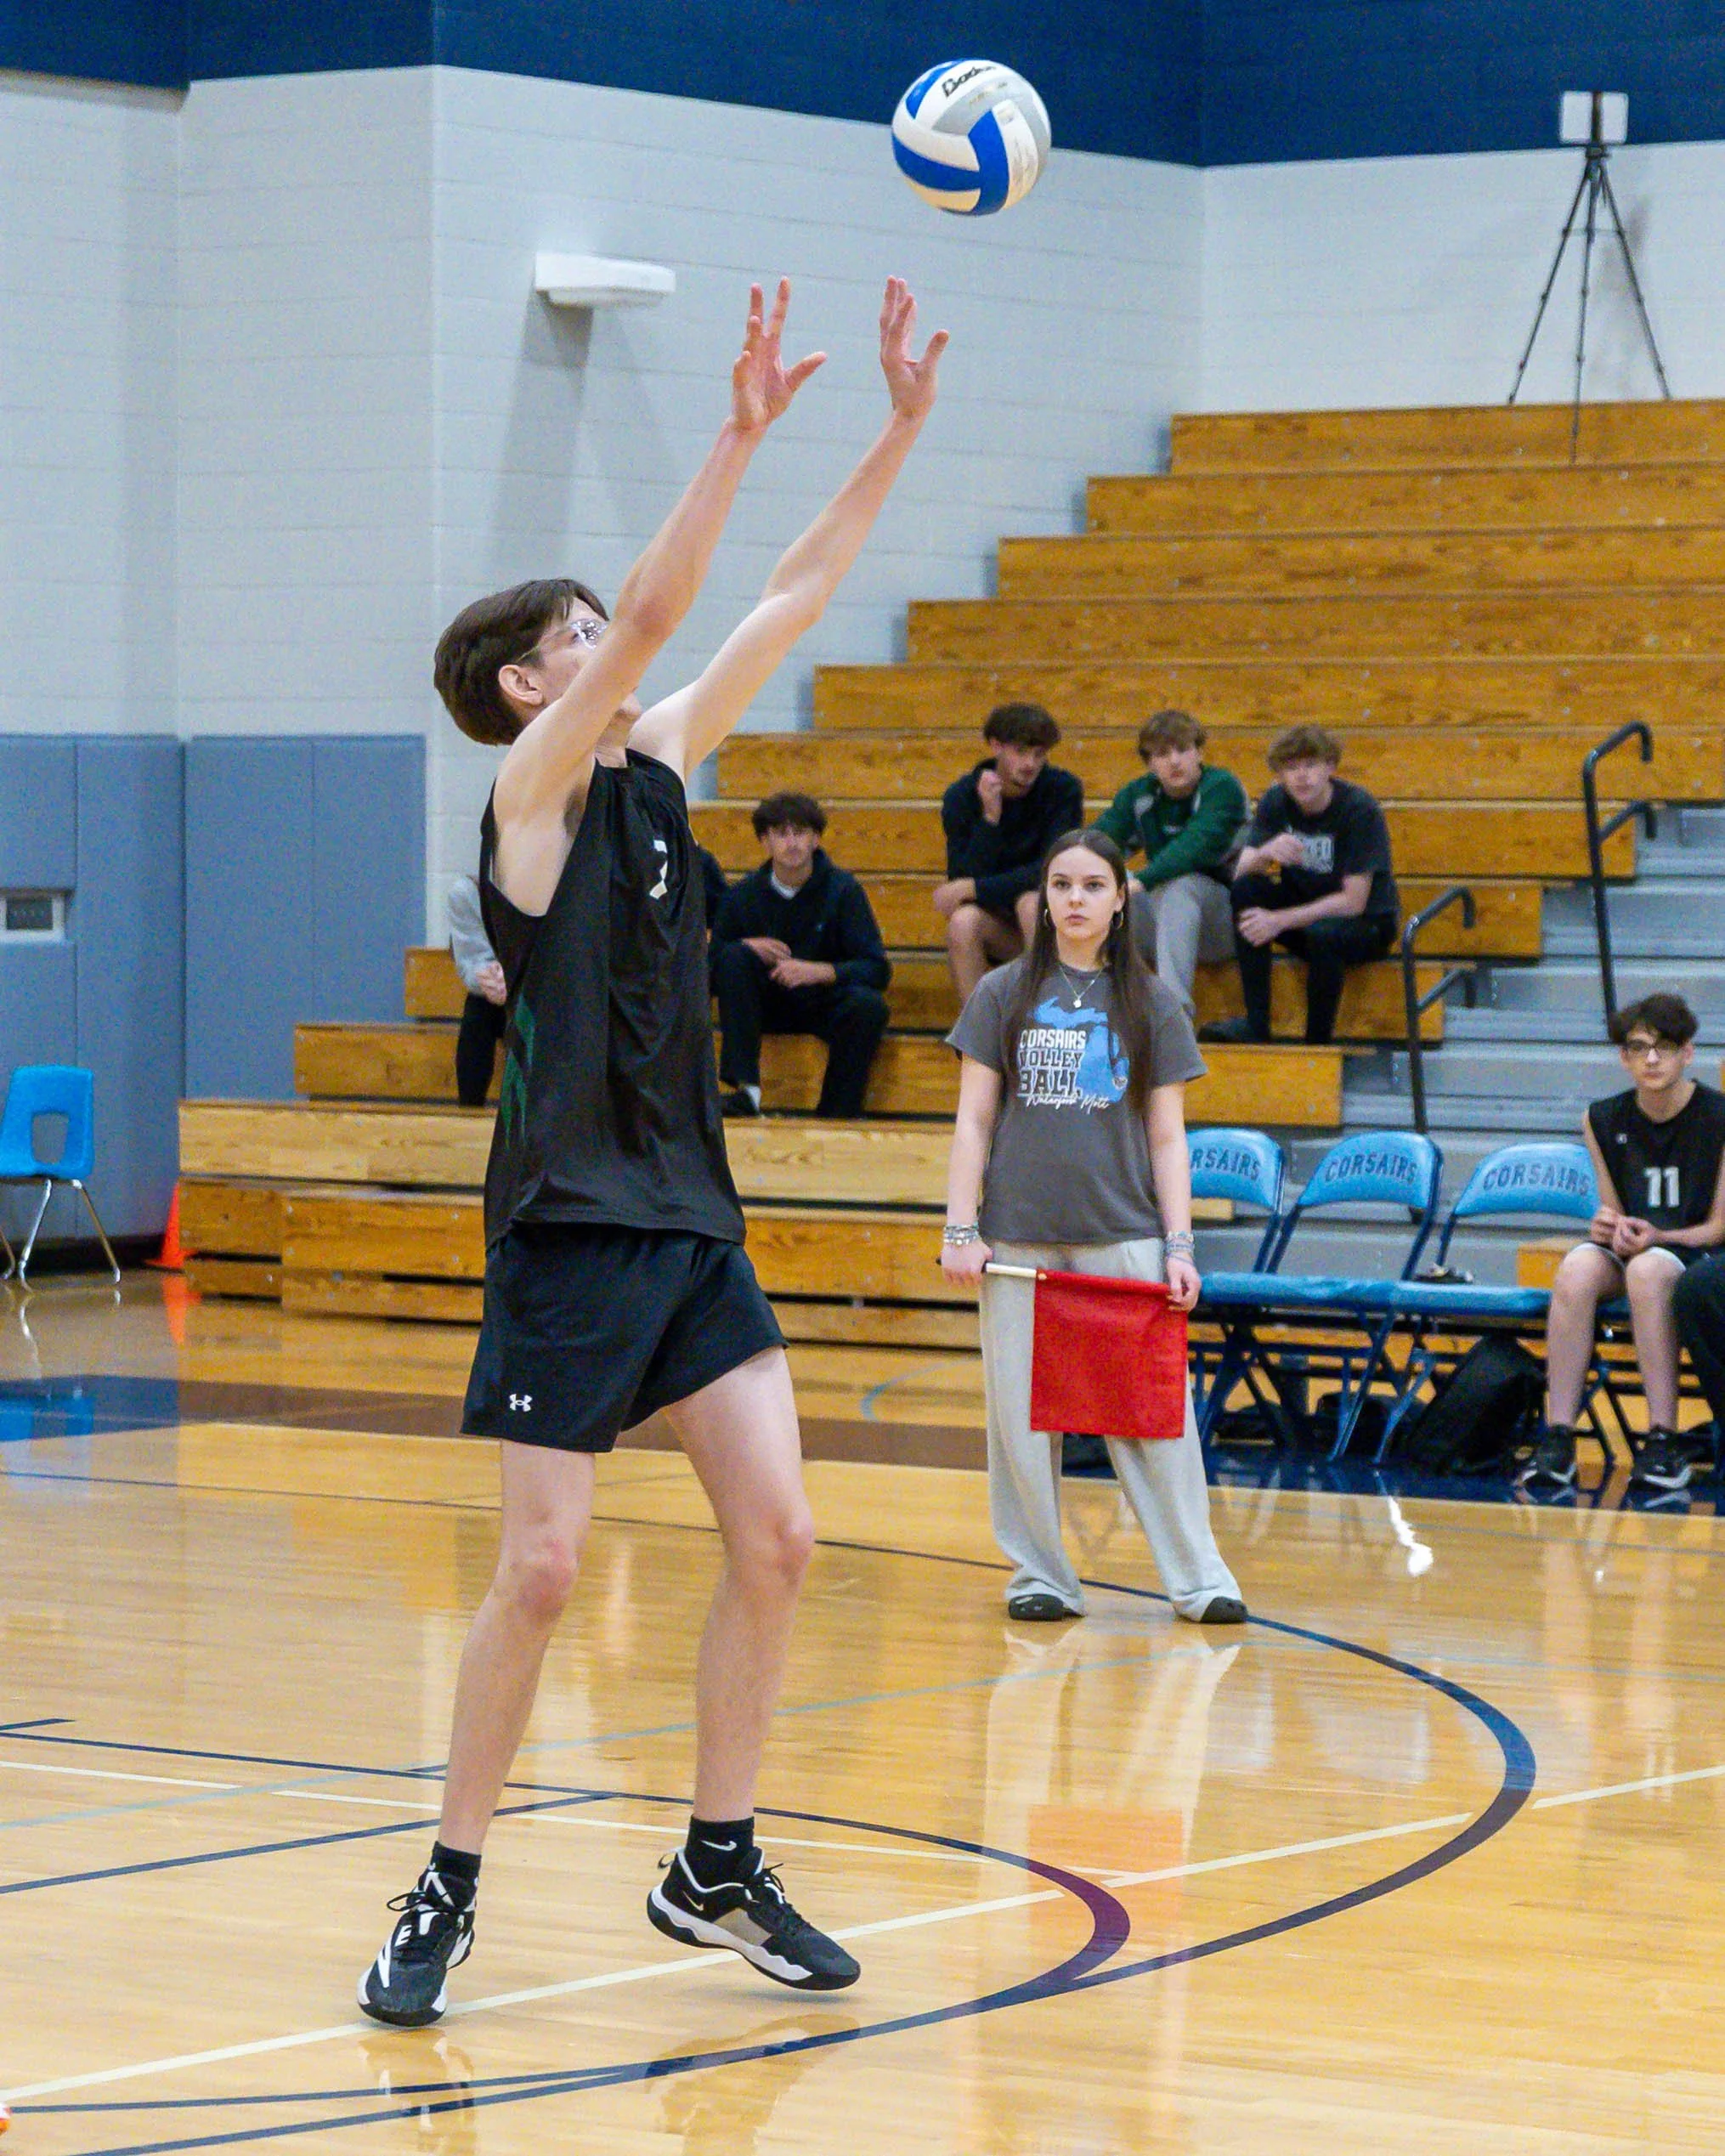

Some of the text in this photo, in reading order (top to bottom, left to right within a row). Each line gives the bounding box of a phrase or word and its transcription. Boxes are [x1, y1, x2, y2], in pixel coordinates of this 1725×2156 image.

[1020, 1028, 1087, 1050] CORSAIRS
[1018, 1048, 1085, 1069] VOLLEY
[1190, 1147, 1261, 1180] RSAIRS
[1325, 1151, 1417, 1184] CORSAIRS
[1482, 1162, 1591, 1197] CORSAIRS
[1644, 1167, 1680, 1208] 11
